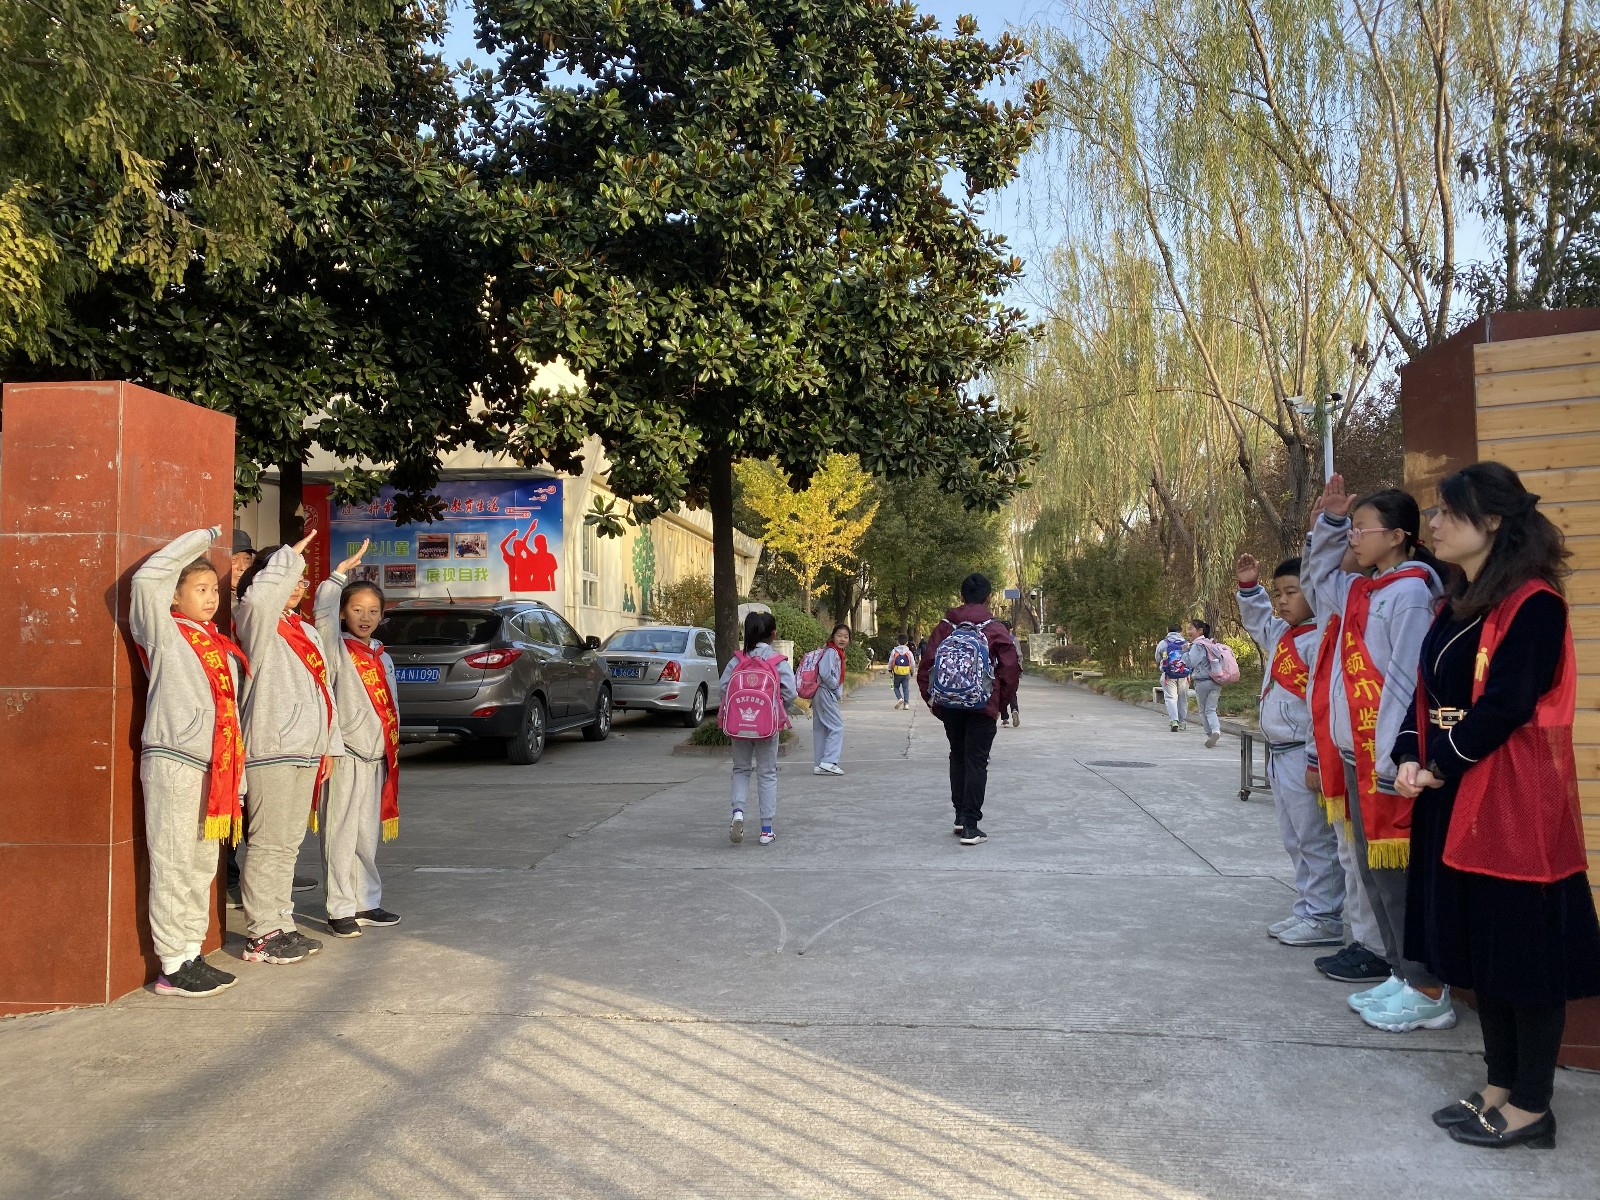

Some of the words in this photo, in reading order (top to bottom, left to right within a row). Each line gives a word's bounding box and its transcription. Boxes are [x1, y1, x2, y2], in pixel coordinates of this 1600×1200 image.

[426, 567, 488, 582] 展现自我
[736, 696, 765, 706] OXFORD
